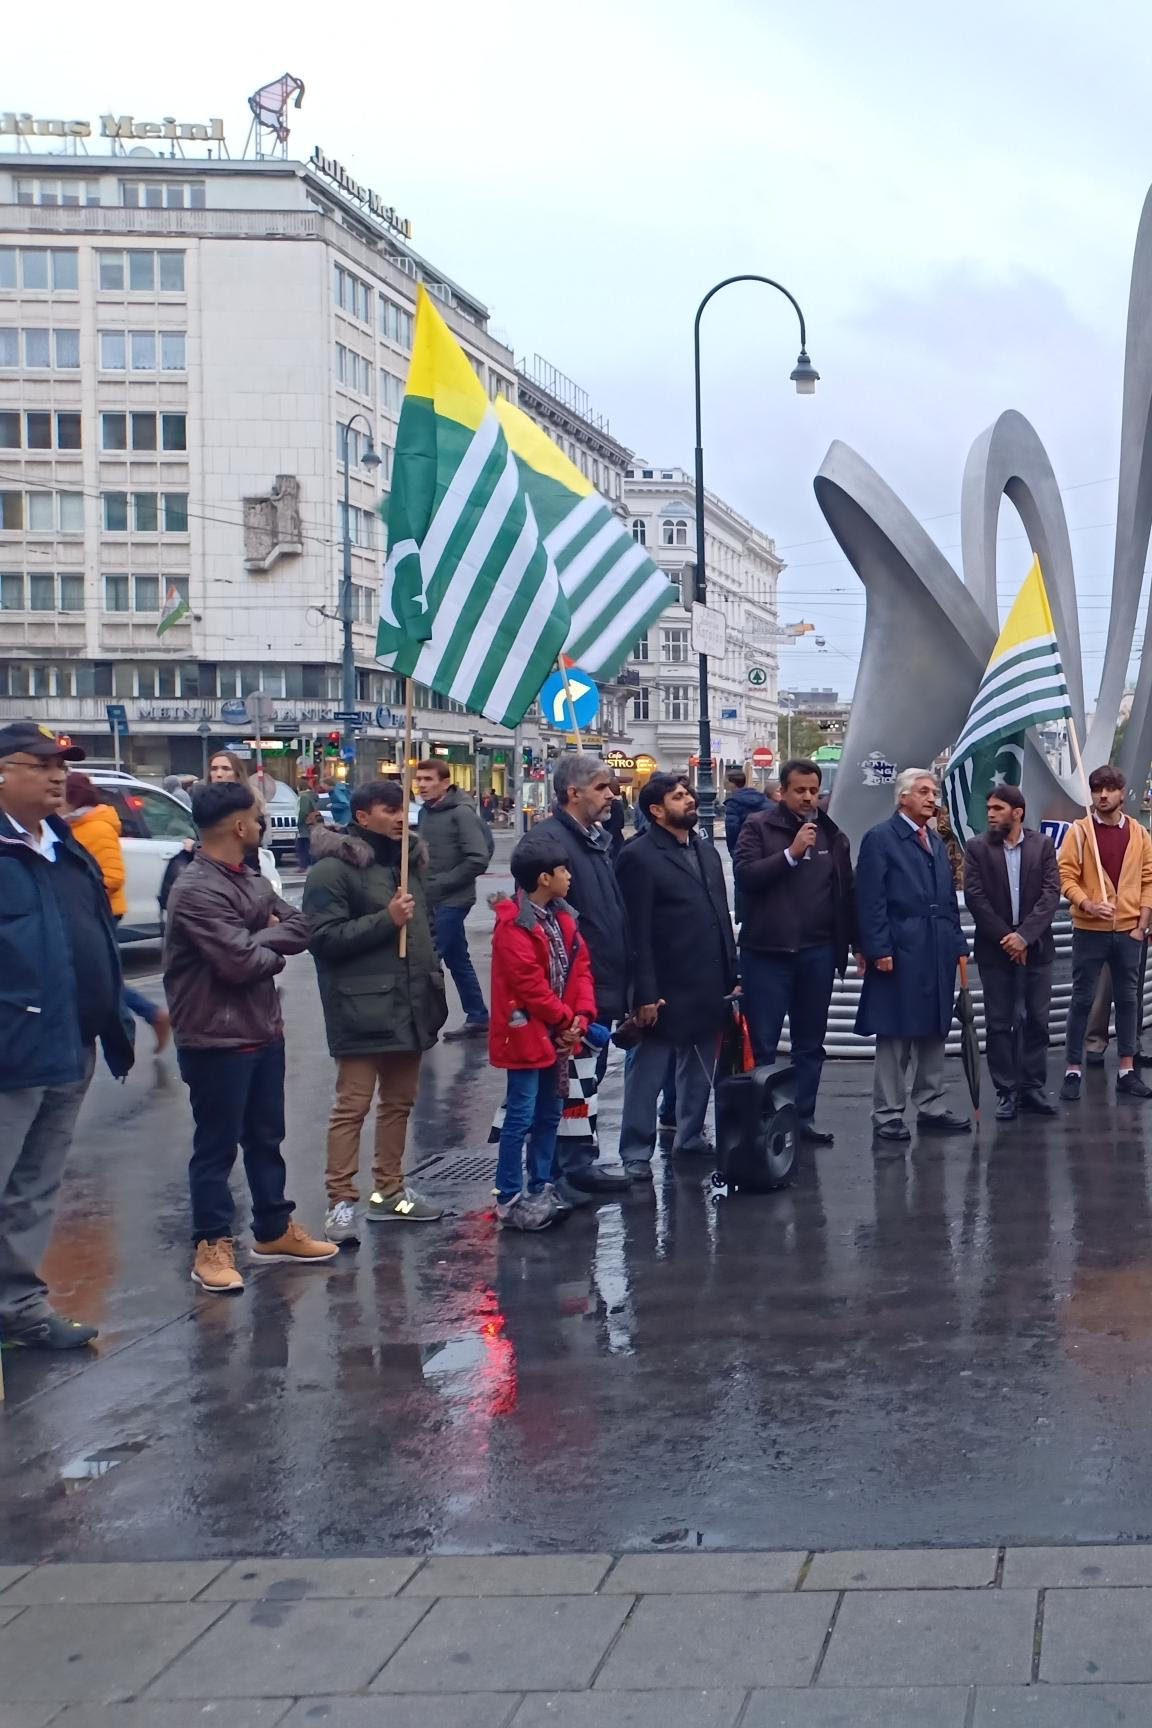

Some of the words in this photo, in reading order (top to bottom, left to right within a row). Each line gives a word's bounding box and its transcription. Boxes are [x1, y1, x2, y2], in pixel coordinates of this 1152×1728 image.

[0, 112, 91, 137] lius
[99, 114, 225, 141] Meinl
[309, 145, 367, 203] Julius
[367, 188, 413, 240] Meinl
[138, 707, 213, 721] MEINL
[604, 759, 635, 768] STRO
